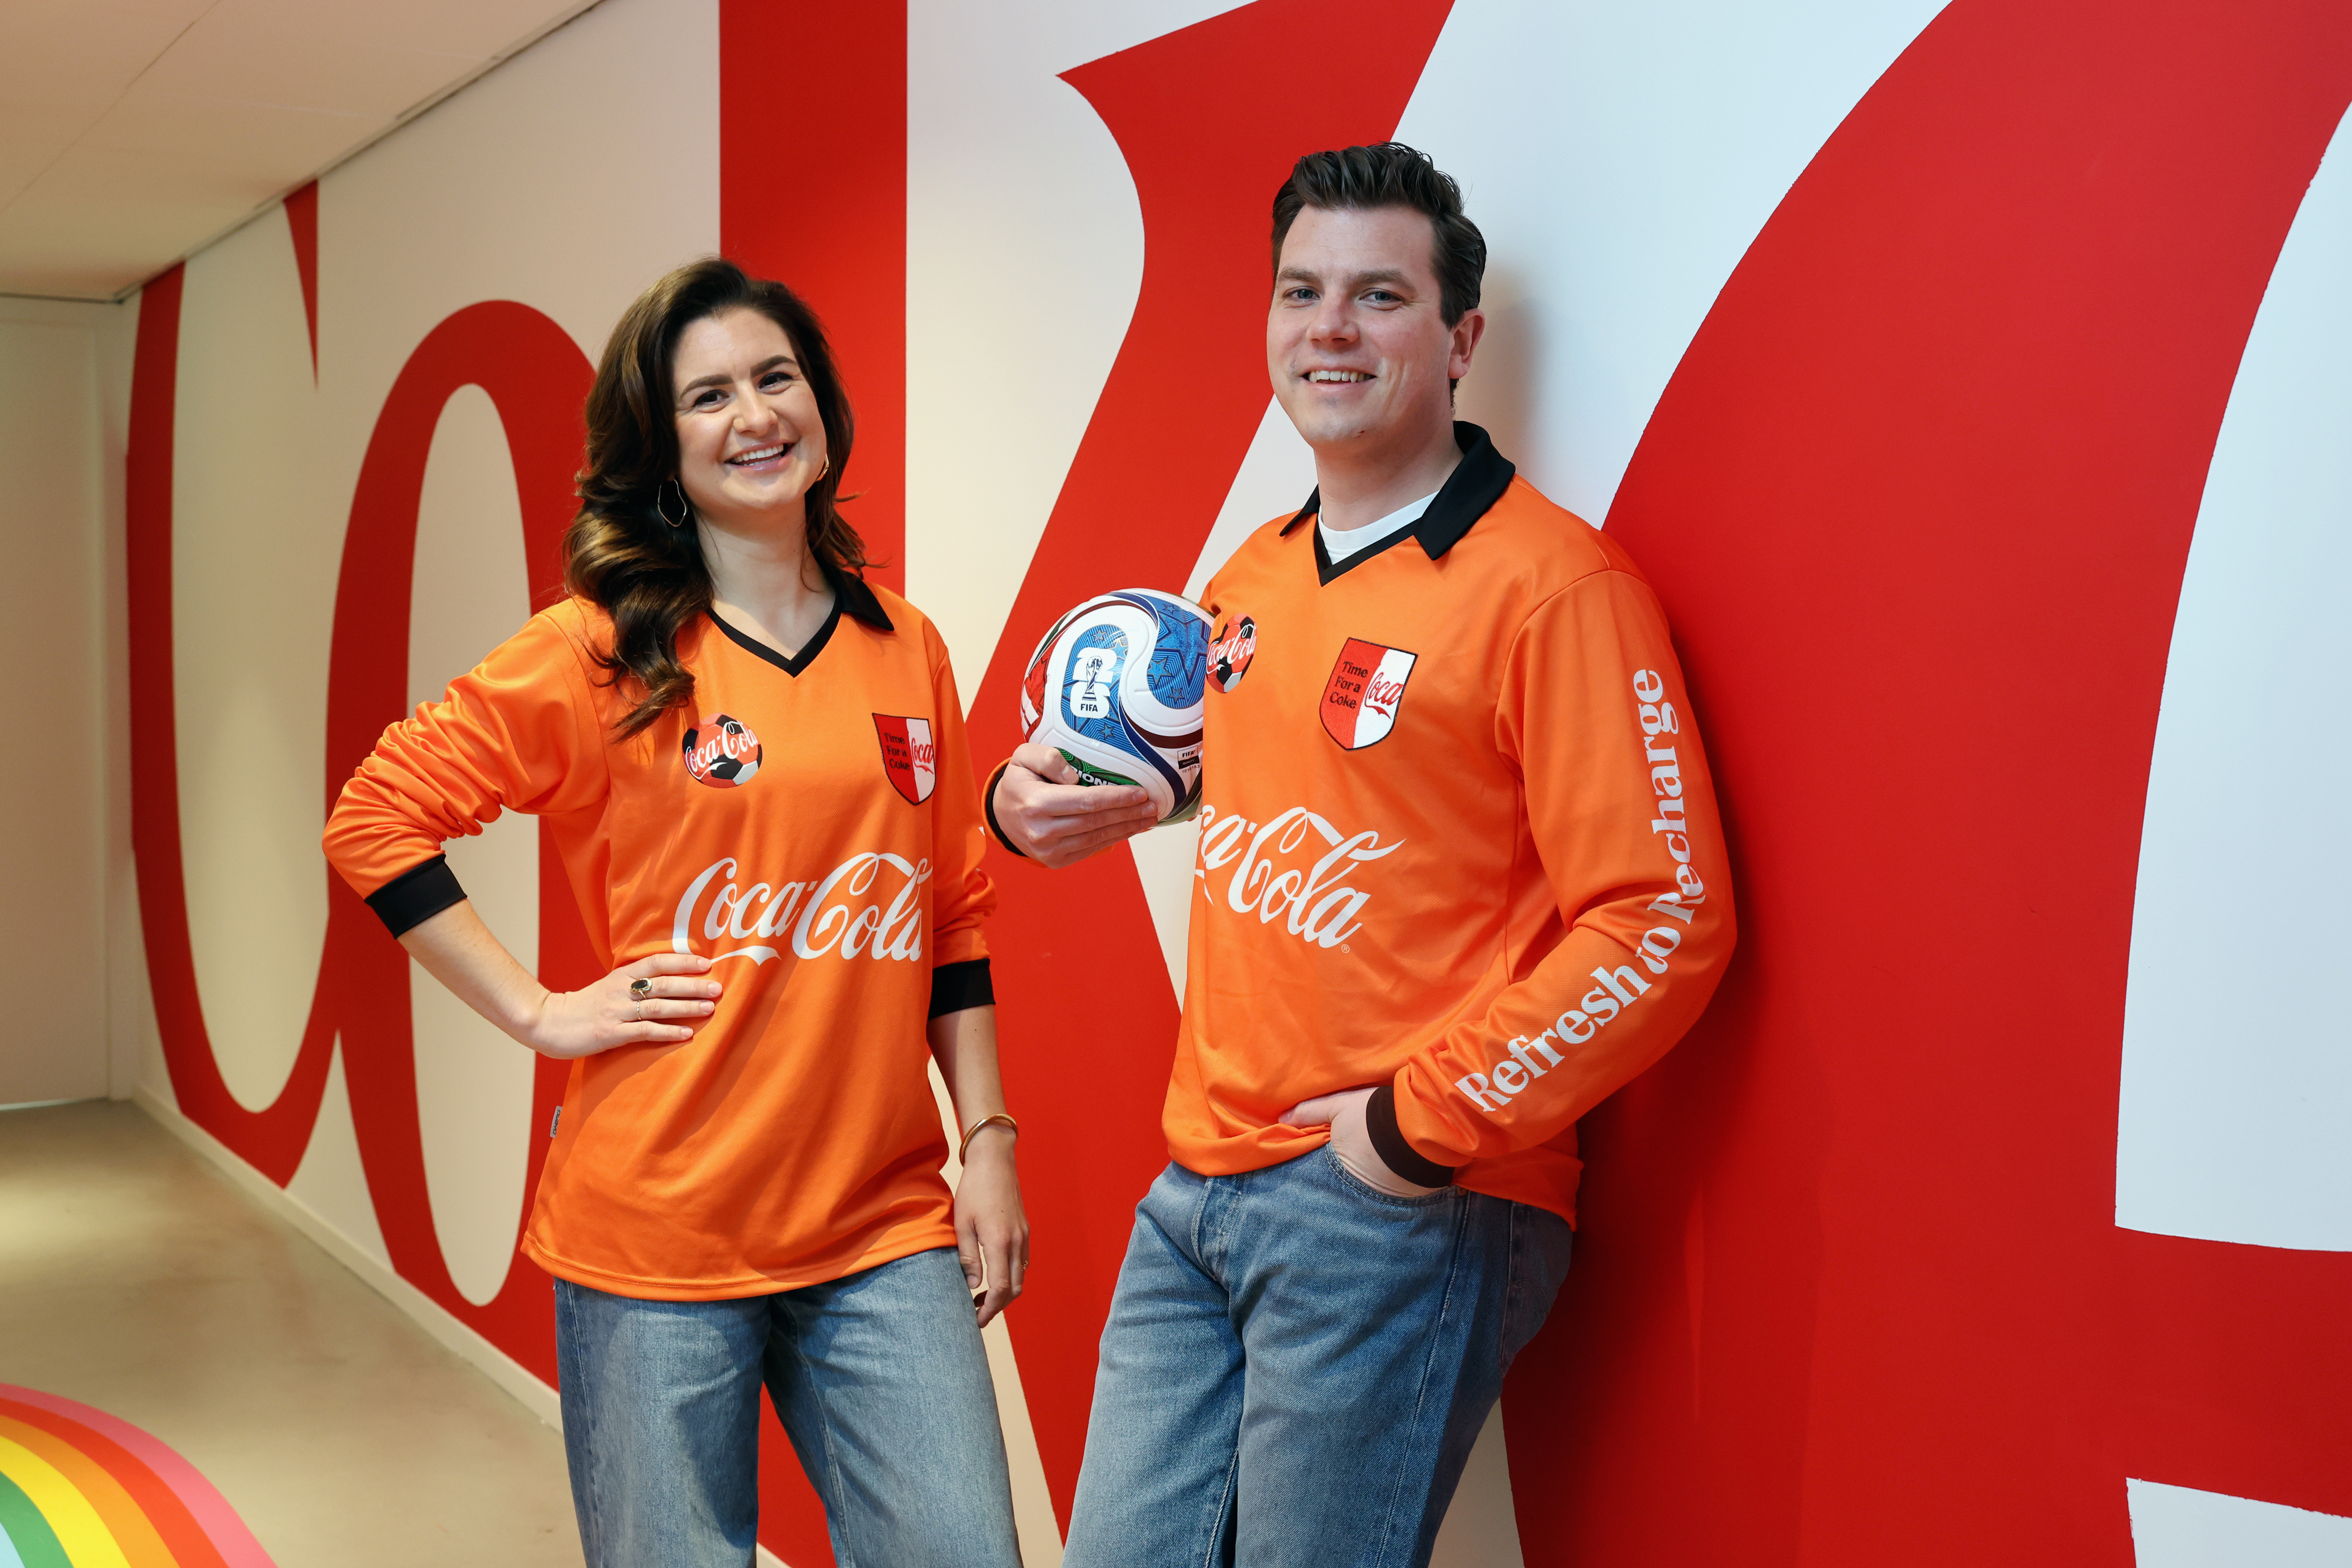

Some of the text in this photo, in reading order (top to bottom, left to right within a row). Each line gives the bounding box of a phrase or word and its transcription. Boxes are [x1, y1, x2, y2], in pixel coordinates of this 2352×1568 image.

[1206, 623, 1257, 674] Coca-Cola
[1343, 661, 1368, 678] Time
[1334, 676, 1361, 693] For a
[1330, 691, 1357, 709] Coke
[1365, 672, 1404, 720] Coca
[1080, 703, 1098, 712] FIFA
[884, 732, 905, 744] Time
[685, 719, 759, 780] Coca-Cola
[886, 745, 901, 756] For
[911, 737, 934, 775] Coca
[889, 758, 910, 770] Coke
[1182, 765, 1200, 773] 1019183
[1454, 669, 1705, 1113] Refresh to Recharge
[672, 852, 933, 966] Coca-Cola
